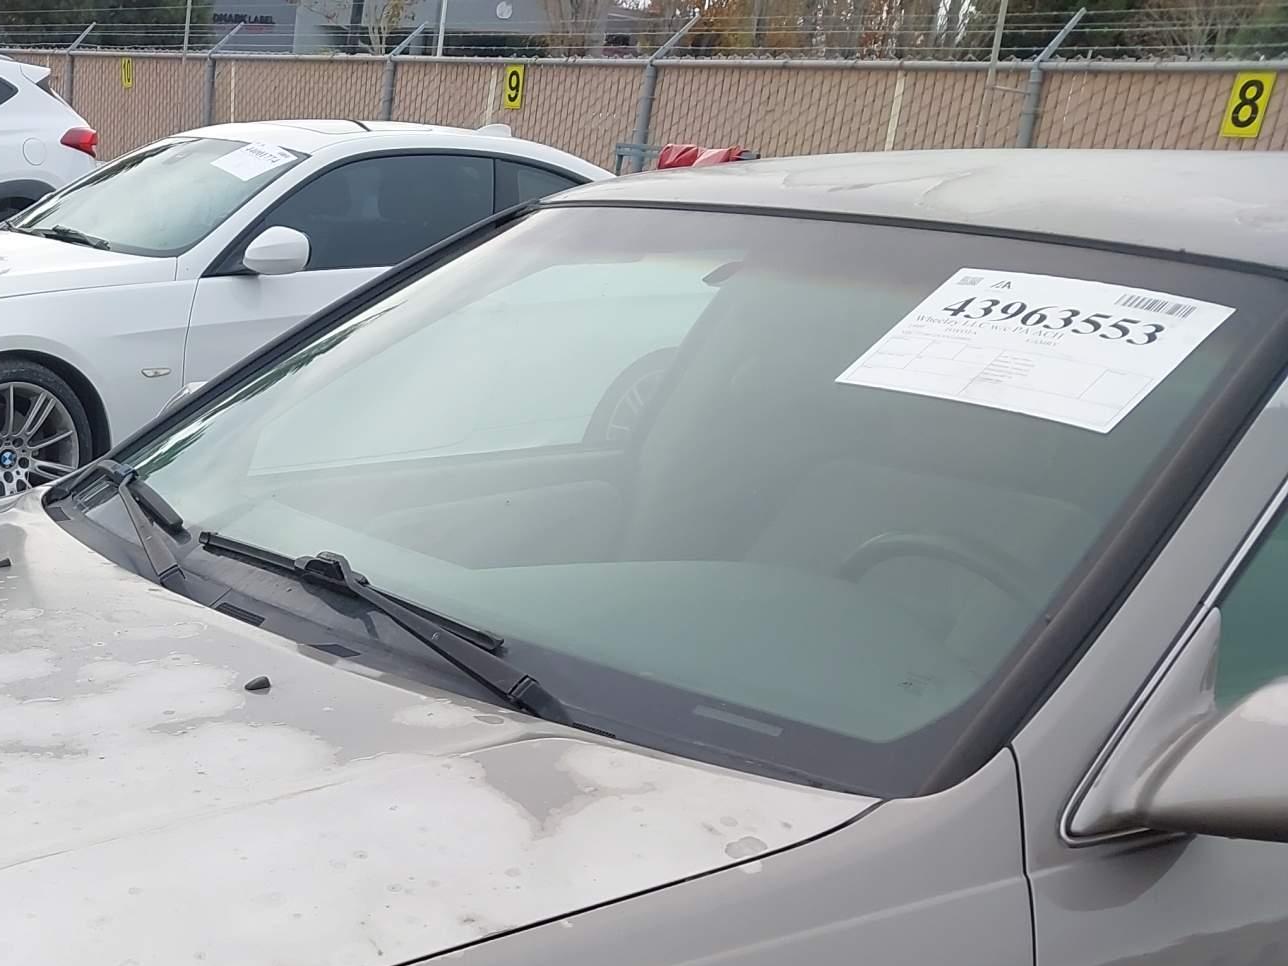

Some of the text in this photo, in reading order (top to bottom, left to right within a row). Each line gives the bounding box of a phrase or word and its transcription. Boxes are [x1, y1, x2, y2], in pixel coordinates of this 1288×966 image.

[249, 15, 276, 24] LABEL
[508, 70, 520, 103] 9
[1231, 79, 1264, 128] 8
[943, 296, 1165, 346] 43963553
